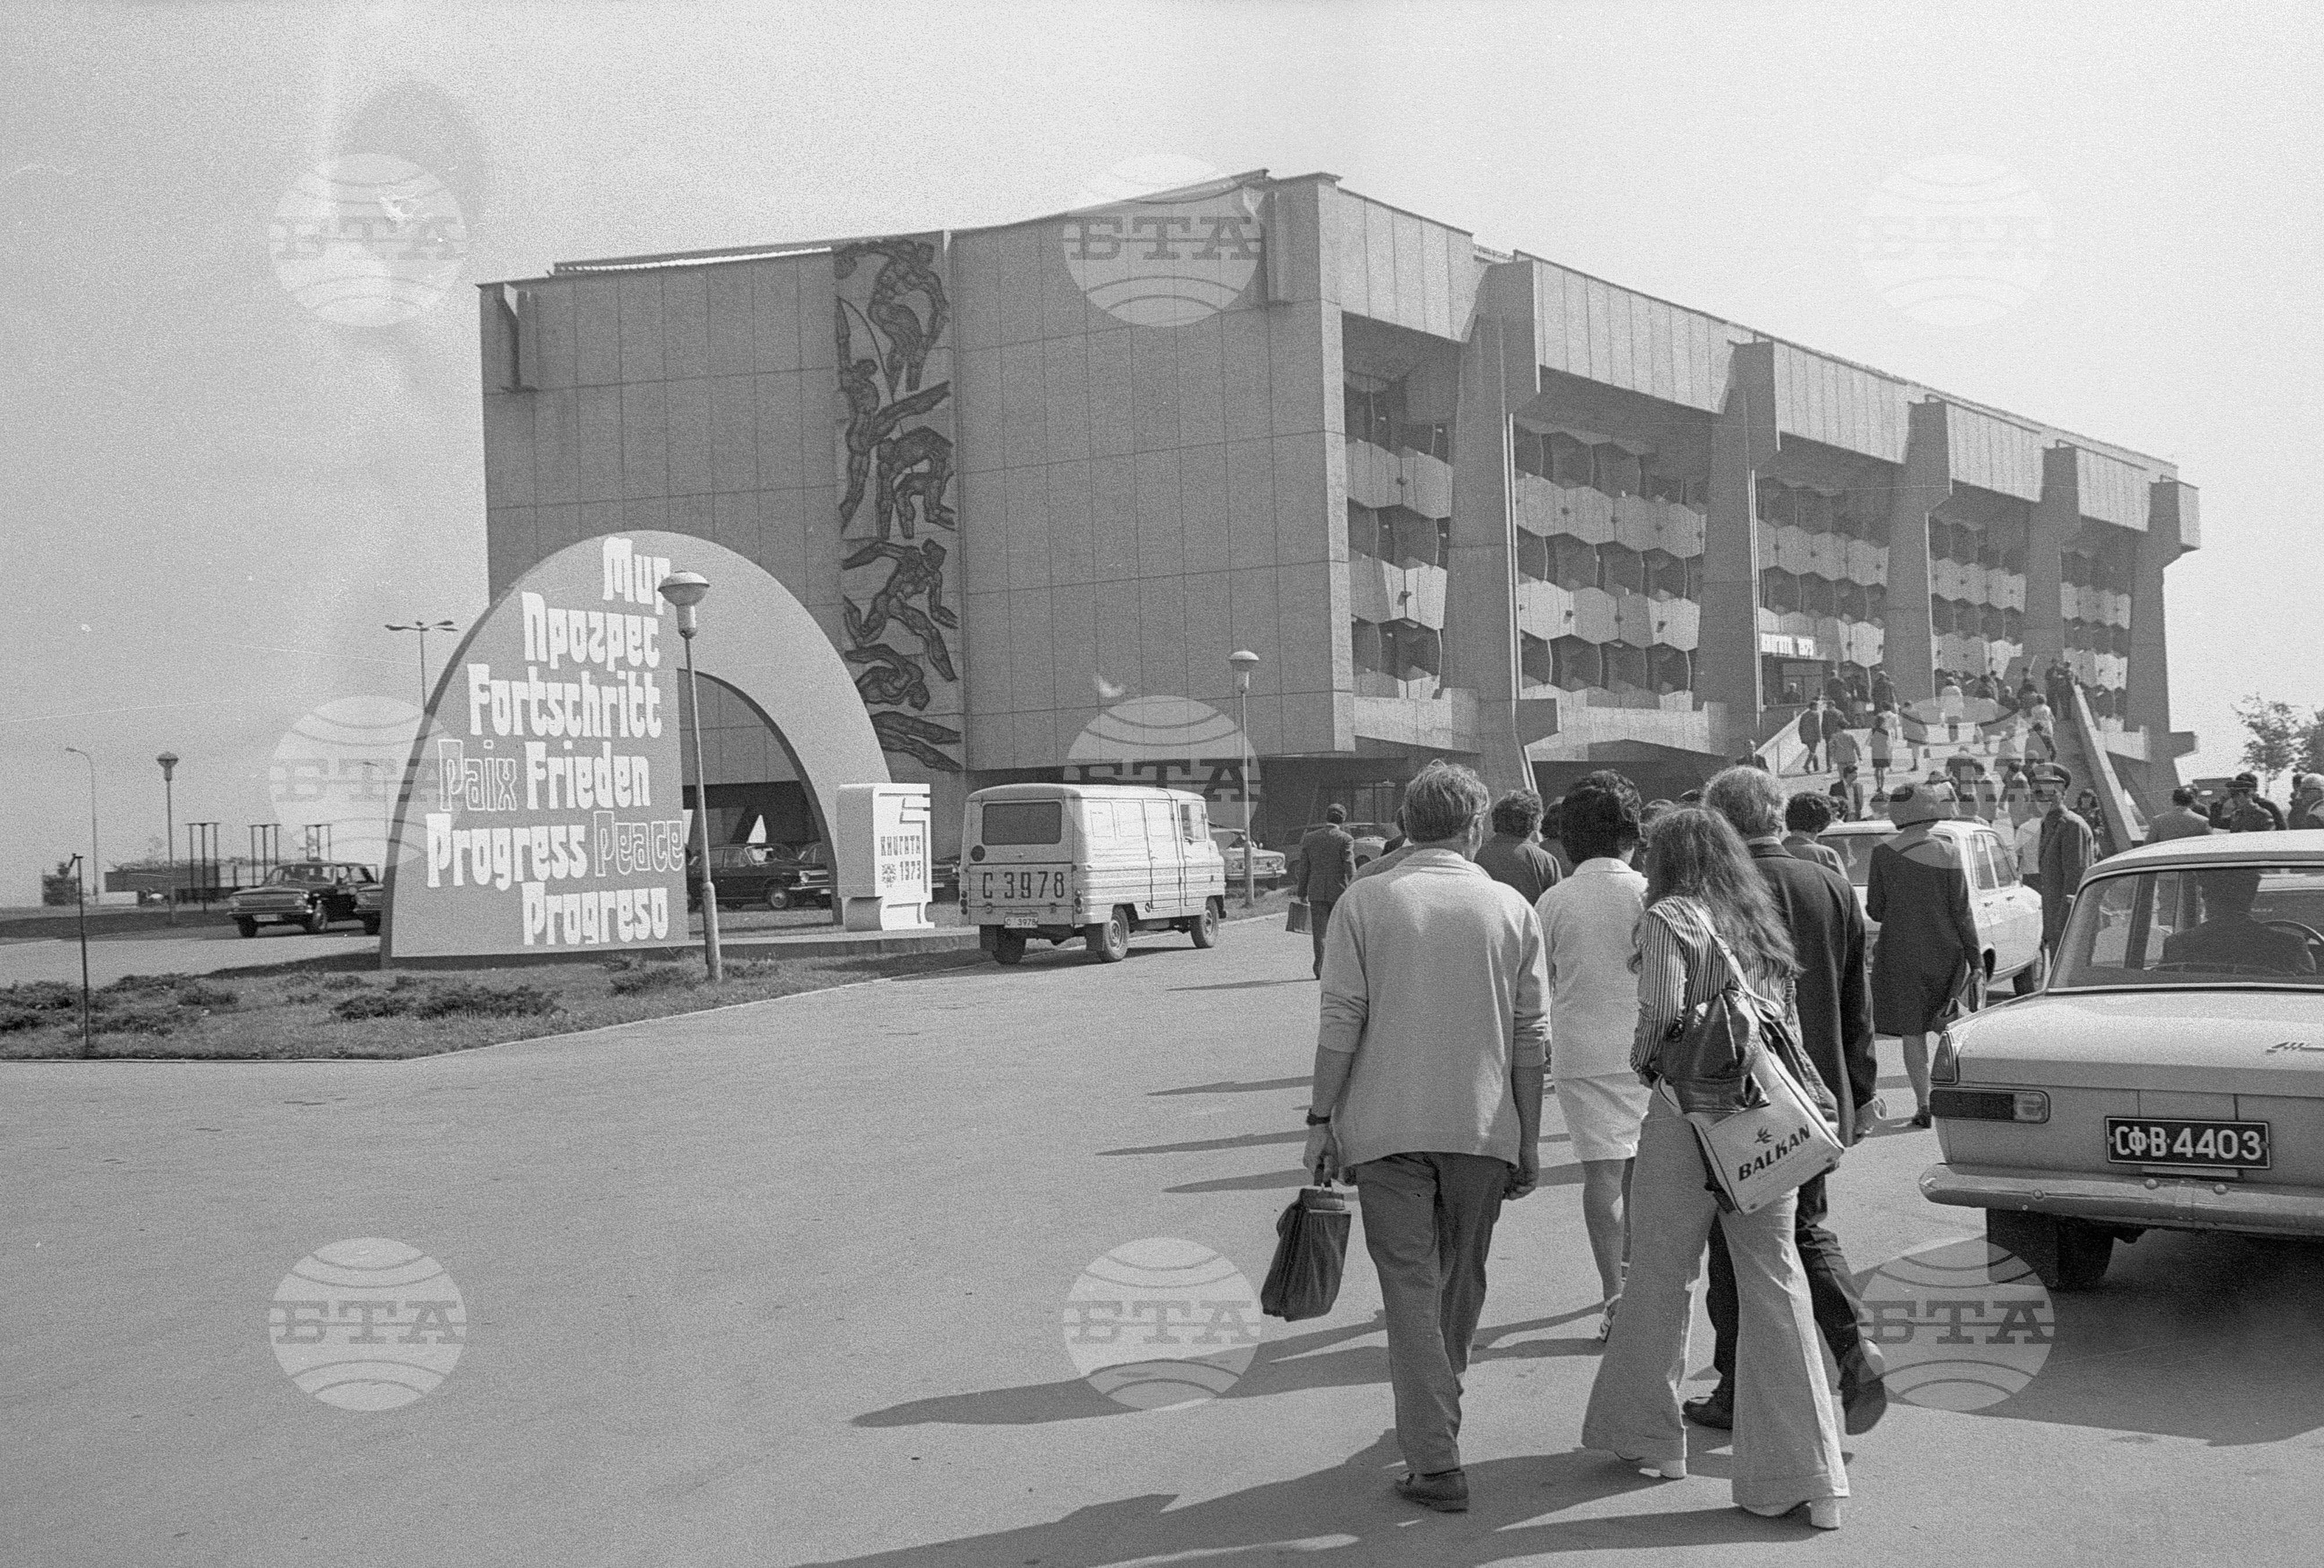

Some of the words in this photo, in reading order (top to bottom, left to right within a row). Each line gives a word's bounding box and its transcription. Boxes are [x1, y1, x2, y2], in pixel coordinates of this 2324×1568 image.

[522, 591, 660, 672] Прогрес
[467, 663, 662, 738] Fortschritt
[437, 738, 517, 812] Paix
[525, 741, 651, 810] Frieden
[426, 813, 586, 891] Progress
[593, 811, 684, 877] Peace
[900, 860, 921, 881] 1973
[1004, 871, 1064, 898] 3978
[521, 881, 669, 945] Progreso
[1738, 1124, 1811, 1181] BALKAN
